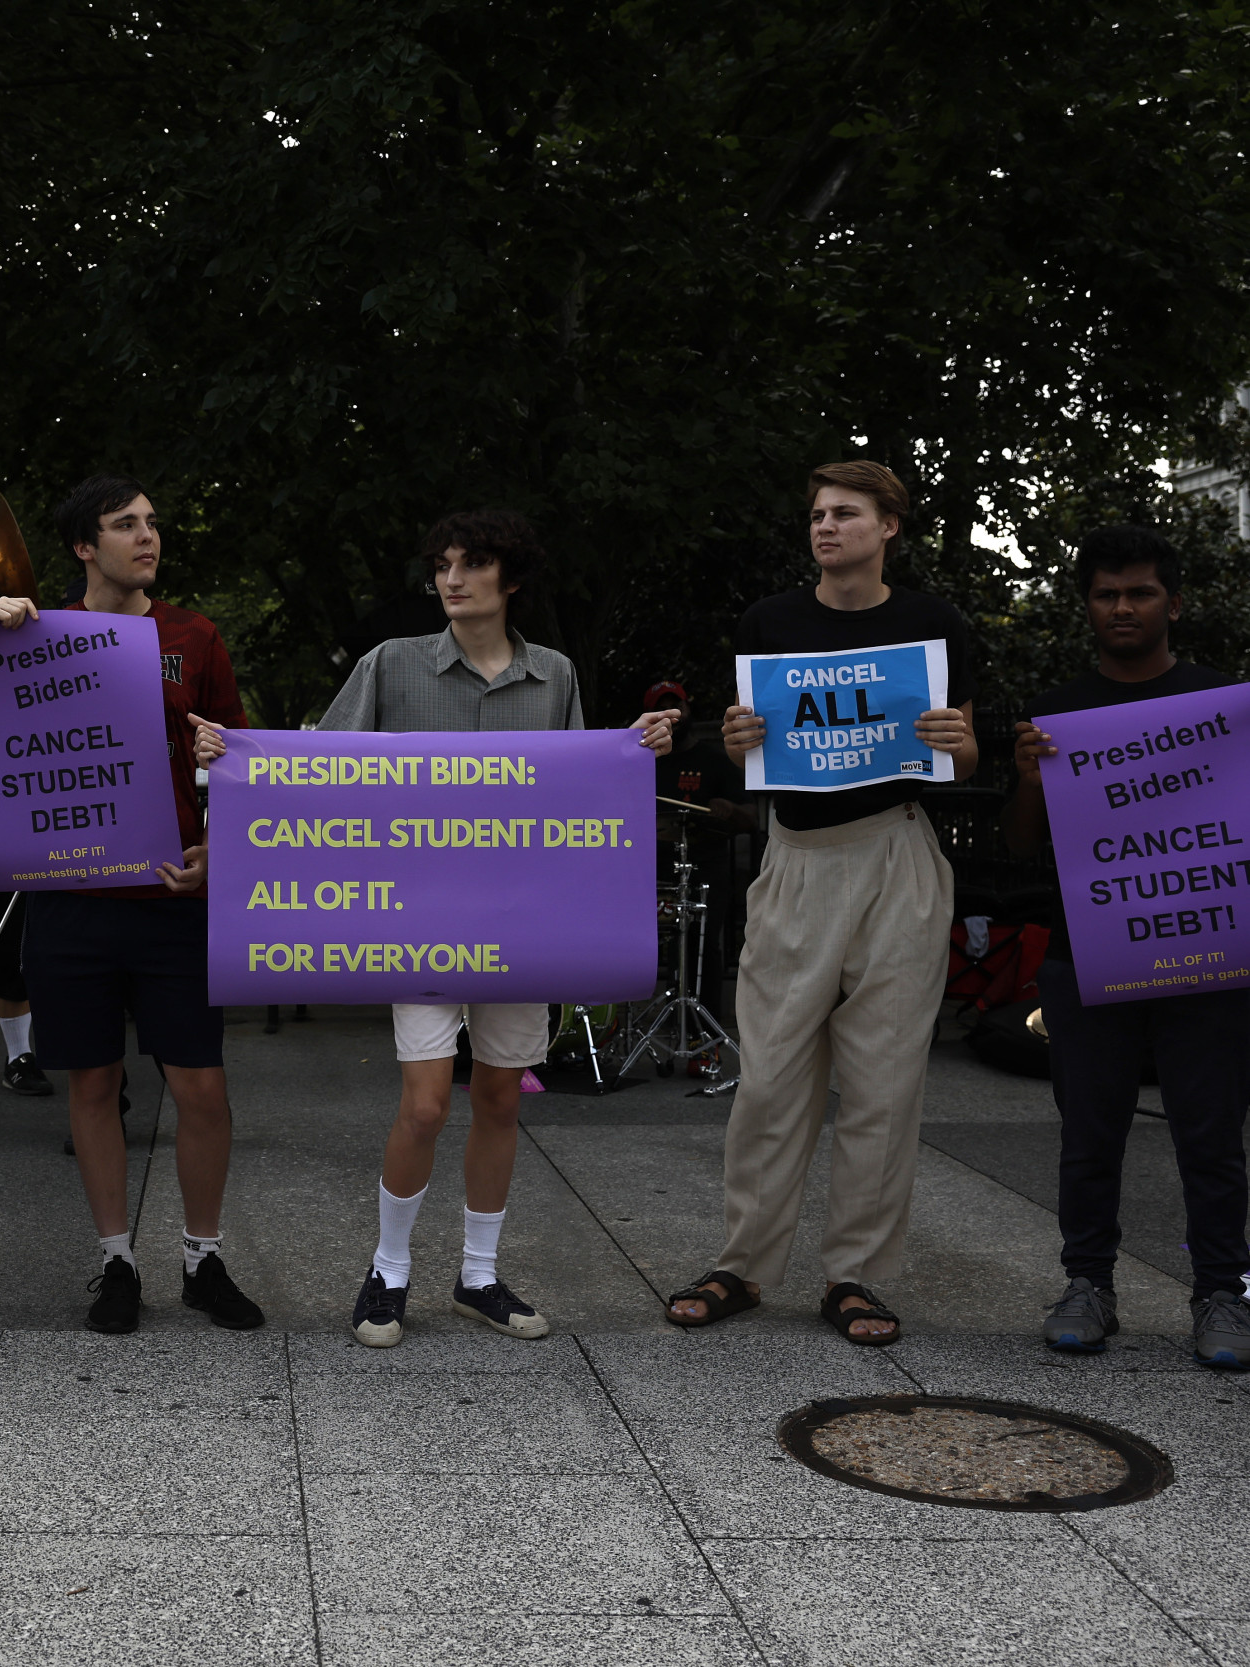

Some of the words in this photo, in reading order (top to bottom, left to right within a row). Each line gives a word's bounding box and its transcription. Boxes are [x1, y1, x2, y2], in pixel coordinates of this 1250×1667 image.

[14, 670, 101, 709] Biden:
[786, 663, 886, 688] CANCEL
[793, 688, 886, 728] ALL
[5, 724, 123, 759] CANCEL
[785, 722, 900, 750] STUDENT
[1068, 712, 1231, 777] President
[249, 756, 424, 786] PRESIDENT
[430, 756, 537, 786] BIDEN:
[810, 747, 875, 771] DEBT
[1, 761, 134, 798] STUDENT
[1104, 764, 1214, 810] Biden:
[31, 802, 117, 833] DEBT!
[248, 818, 381, 848] CANCEL
[387, 818, 537, 848] STUDENT
[543, 818, 633, 848] DEBT.
[1092, 821, 1243, 863] CANCEL
[48, 849, 71, 861] ALL
[72, 847, 88, 859] OF
[91, 845, 106, 857] IT!
[12, 868, 87, 881] means-testing
[89, 865, 99, 876] is
[101, 859, 150, 876] garbage!
[246, 881, 308, 910] ALL
[314, 881, 360, 910] OF
[367, 881, 404, 911] IT.
[1126, 905, 1237, 942] DEBT!
[248, 943, 317, 973] FOR
[323, 943, 510, 973] EVERYONE.
[1153, 957, 1181, 970] ALL
[1184, 954, 1203, 966] OF
[1207, 951, 1226, 963] IT!
[1104, 975, 1199, 993] means-testing
[1202, 972, 1214, 981] is
[1218, 967, 1250, 981] garb
